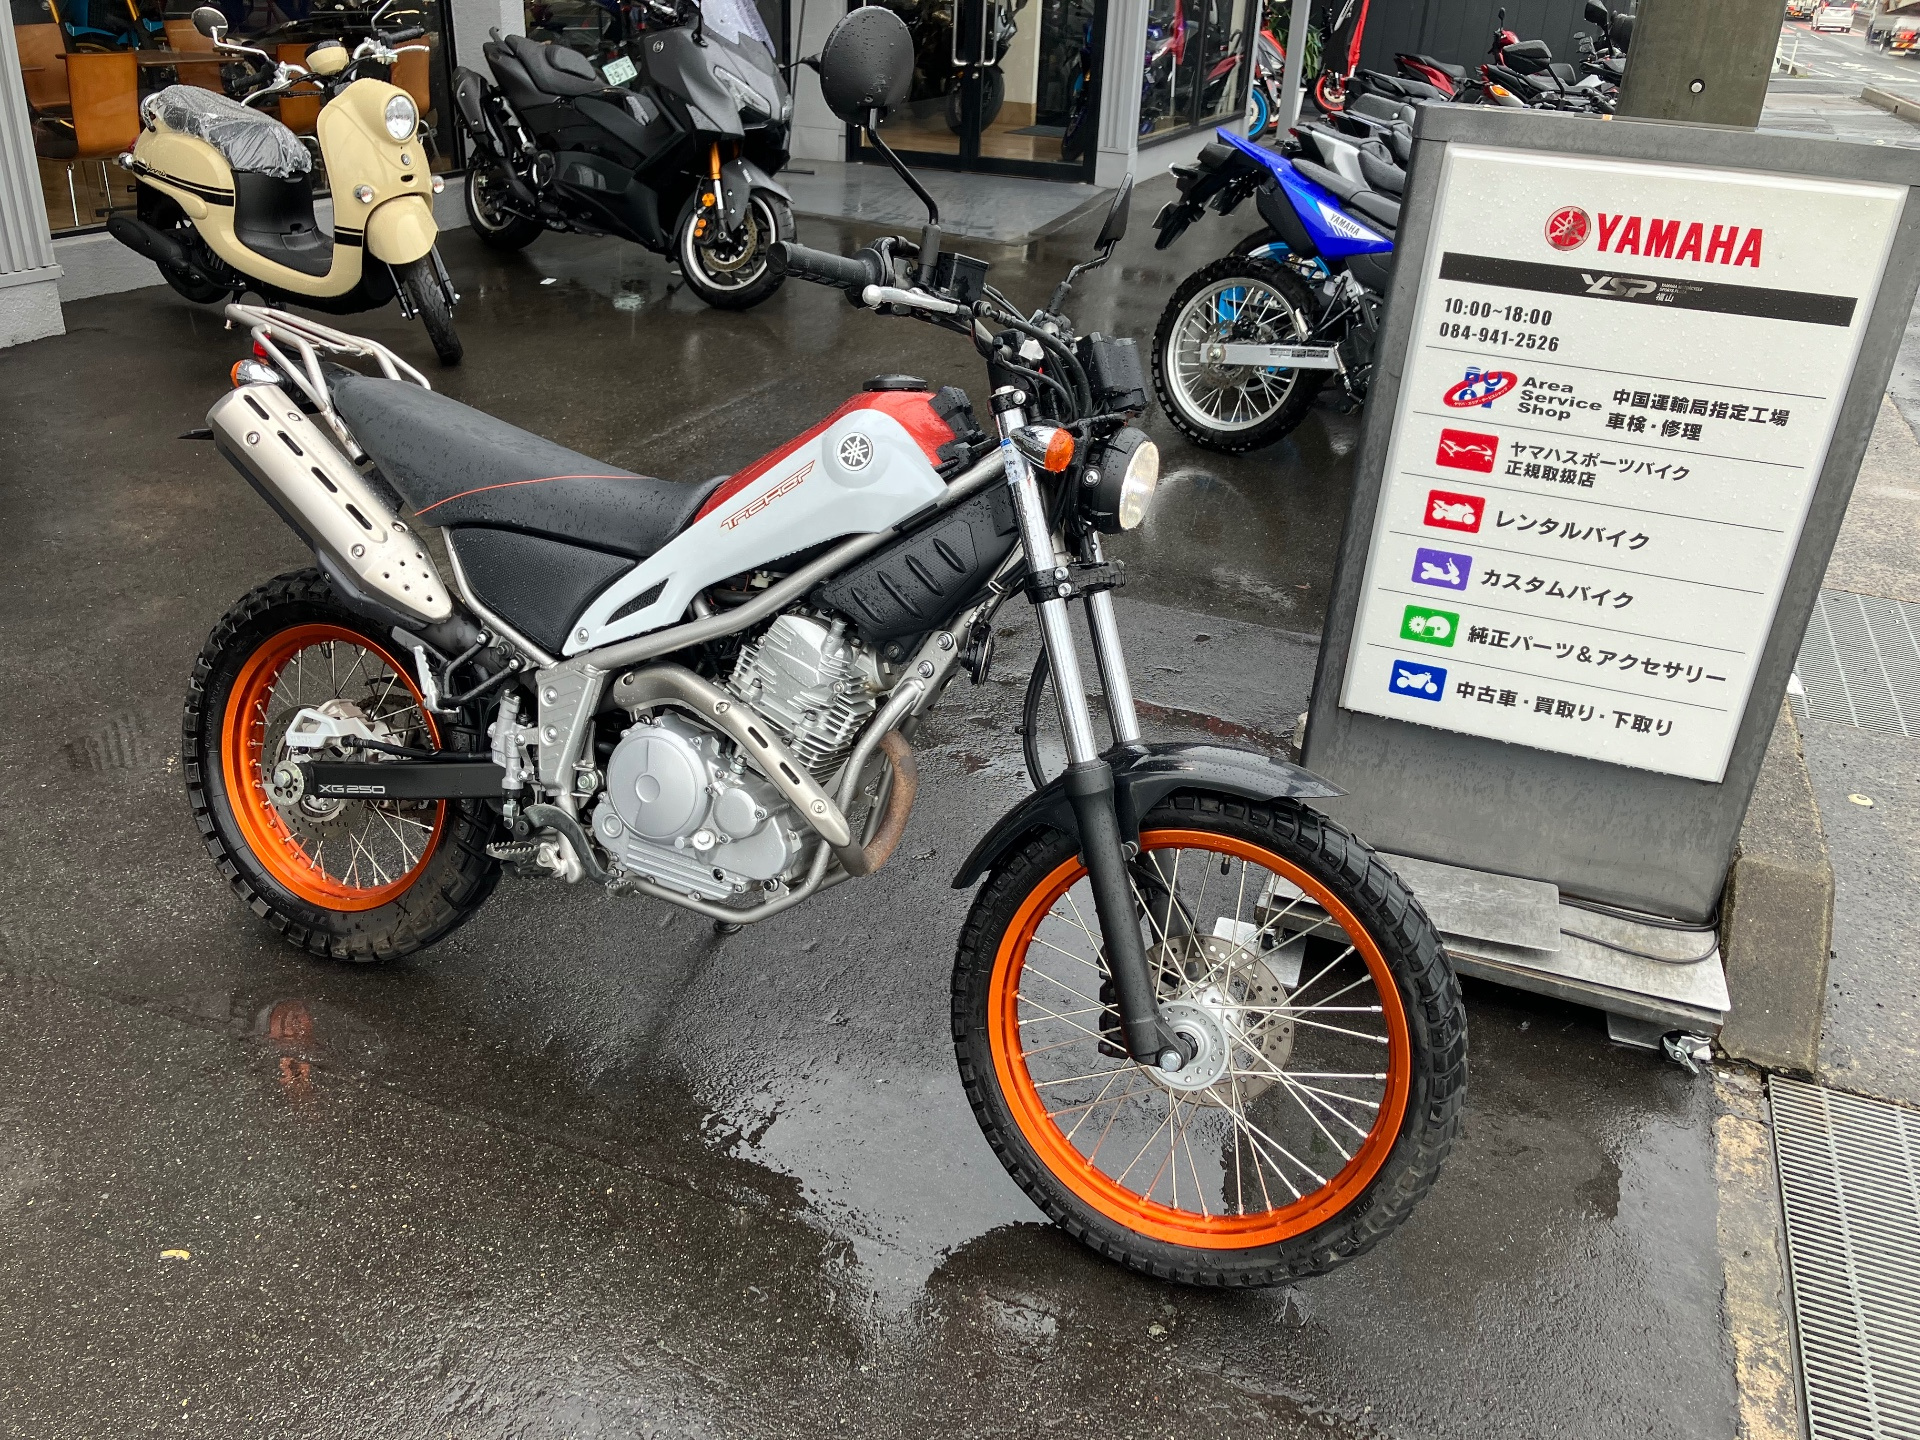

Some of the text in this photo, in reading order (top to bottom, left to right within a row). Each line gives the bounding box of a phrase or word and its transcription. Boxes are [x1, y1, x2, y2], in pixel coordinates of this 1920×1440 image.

[1330, 213, 1361, 236] YAMAHA
[1597, 212, 1763, 268] YAMAHA
[1581, 273, 1658, 298] YSP
[1444, 298, 1553, 326] 10:00~18:00
[1439, 322, 1560, 352] 084-941-2526
[1522, 376, 1574, 394] Area
[1517, 402, 1571, 421] Shop
[1519, 389, 1603, 412] Service
[1612, 388, 1791, 428] 中国運輸局指定工場
[1605, 412, 1703, 442] 車検・修理
[1504, 460, 1597, 488] 正規取扱店
[1510, 441, 1691, 482] ヤマハスポーツバイク
[1496, 510, 1650, 551] レンタルバイク
[1480, 569, 1634, 610] カスタムバイク
[1467, 625, 1727, 684] 純正パーツ&アクセサリー
[1455, 681, 1673, 737] 中古車・買取り・下取り
